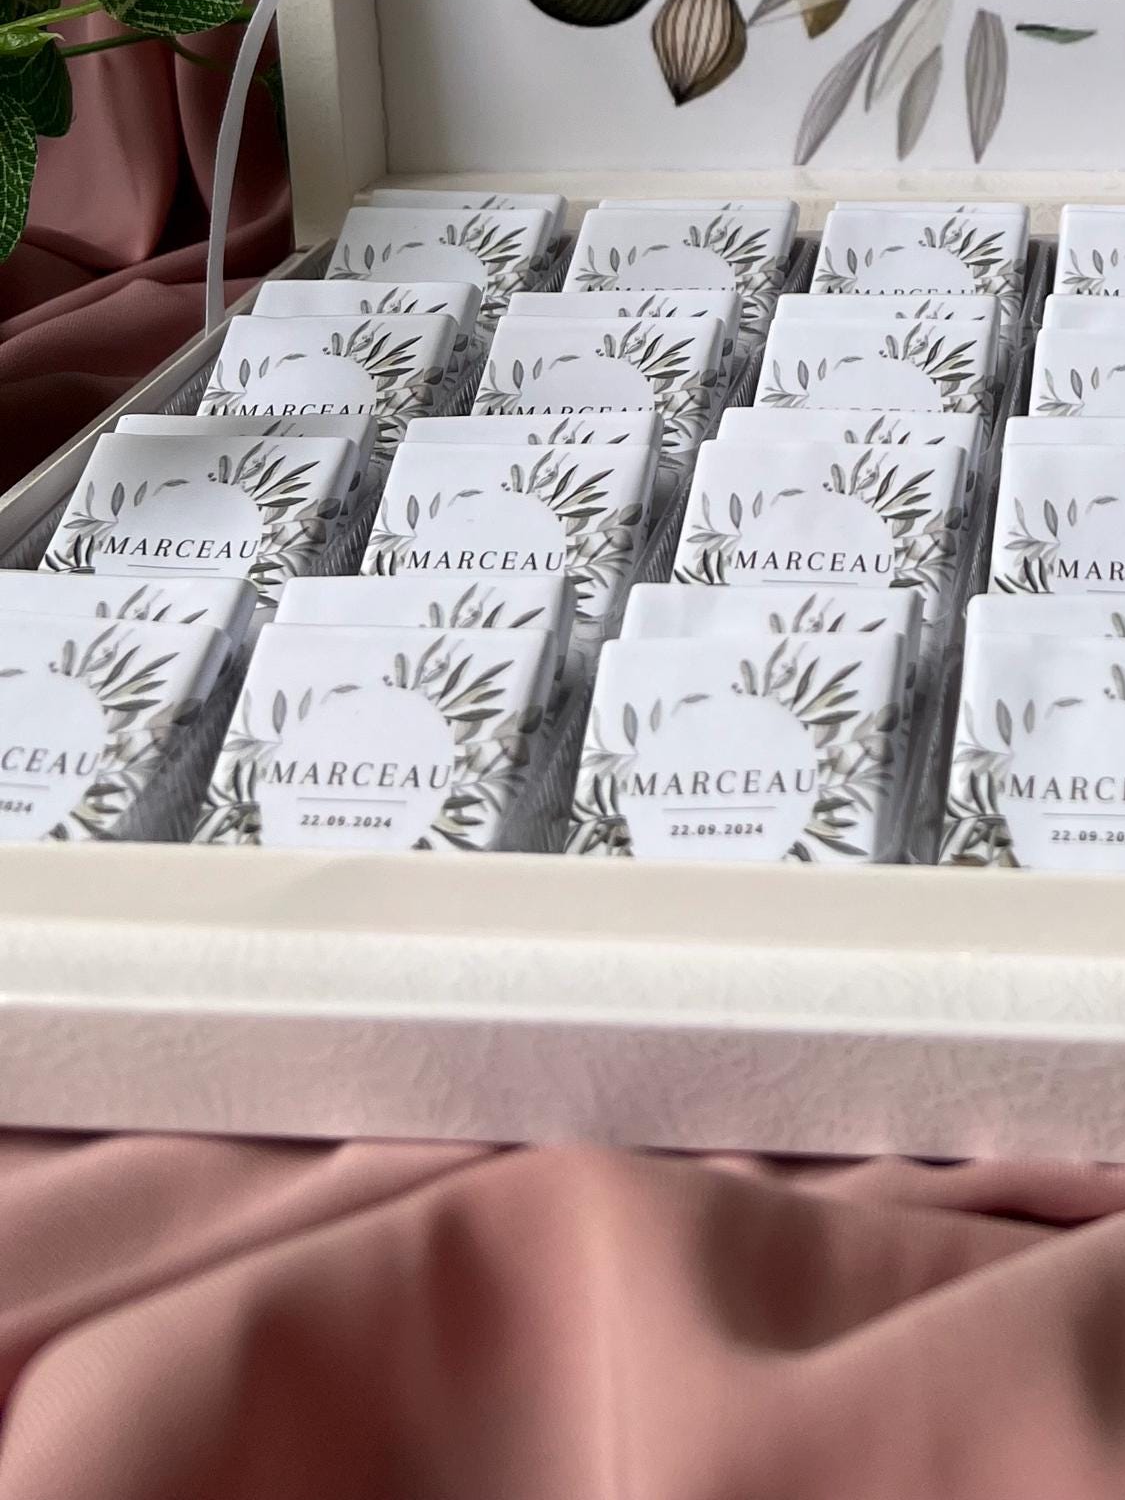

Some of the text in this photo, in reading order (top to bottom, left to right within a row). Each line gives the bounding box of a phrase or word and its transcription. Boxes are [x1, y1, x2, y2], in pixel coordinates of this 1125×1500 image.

[103, 536, 259, 559] MARCEAU
[406, 550, 565, 571] MARCEAU
[734, 549, 893, 574] MARCEAU
[0, 746, 101, 776] CEAU
[268, 760, 452, 790] MARCEAU
[631, 768, 816, 797] MARCEAU
[301, 814, 393, 828] 22.09.2024
[671, 823, 764, 837] 22.09.2024
